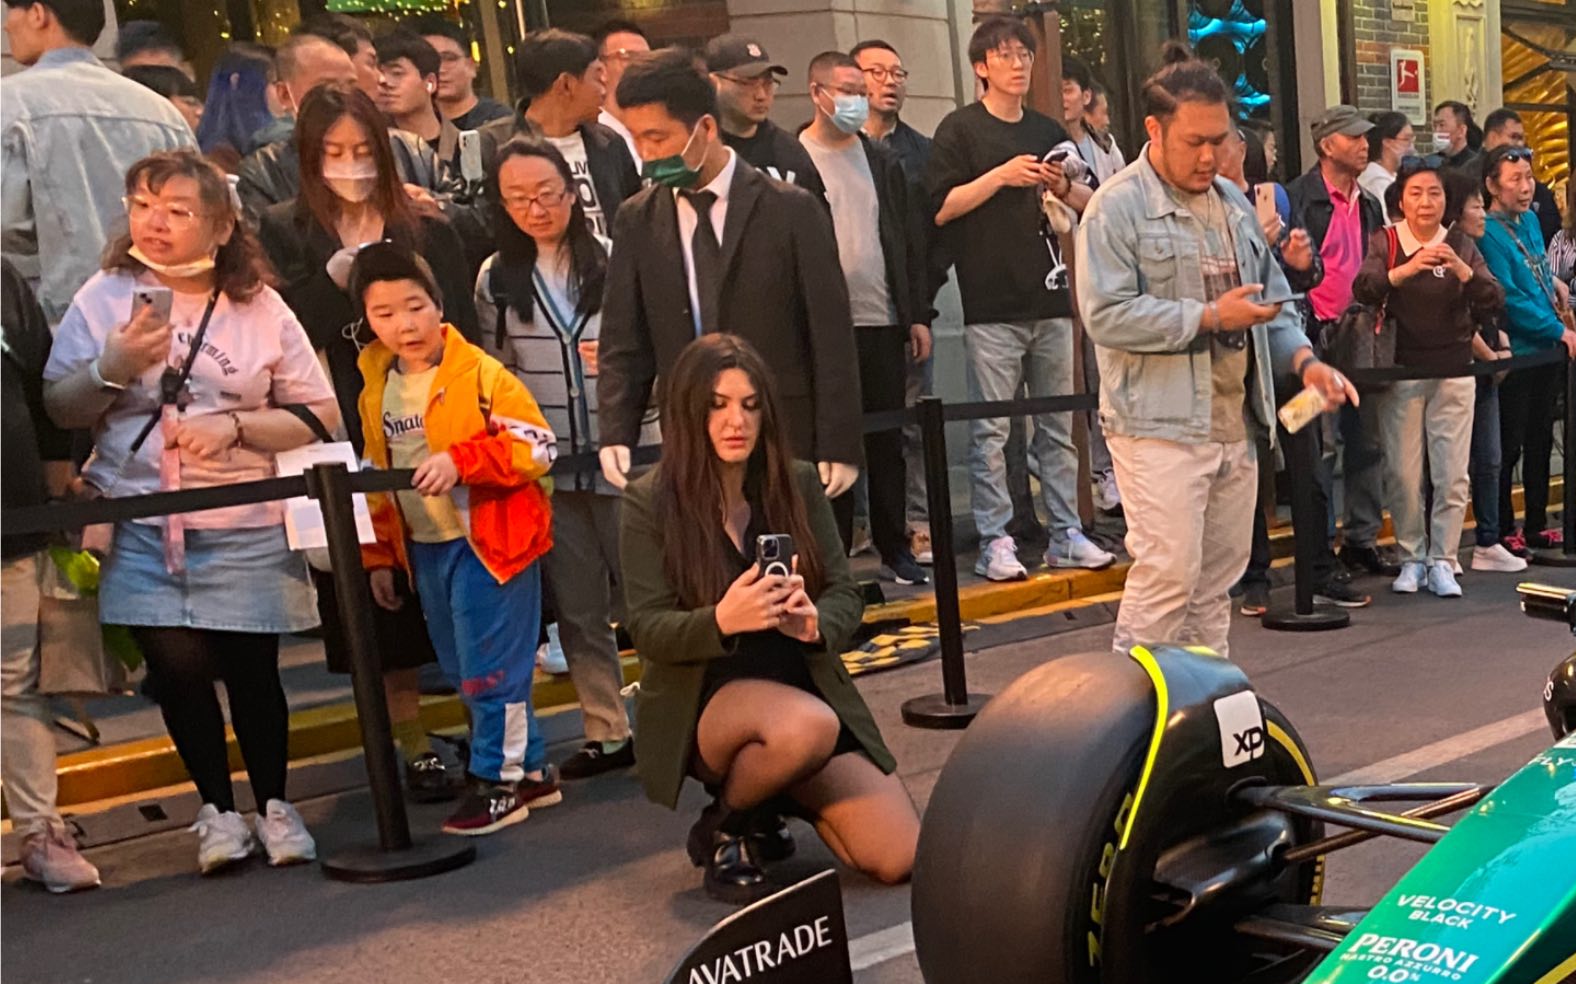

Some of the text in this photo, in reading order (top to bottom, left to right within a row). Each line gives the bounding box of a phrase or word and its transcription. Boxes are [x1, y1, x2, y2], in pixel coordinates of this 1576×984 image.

[1396, 894, 1517, 925] VELOCITY
[1408, 910, 1474, 930] BLACK
[1346, 933, 1480, 974] PERONI
[1393, 959, 1463, 981] AZZURRO
